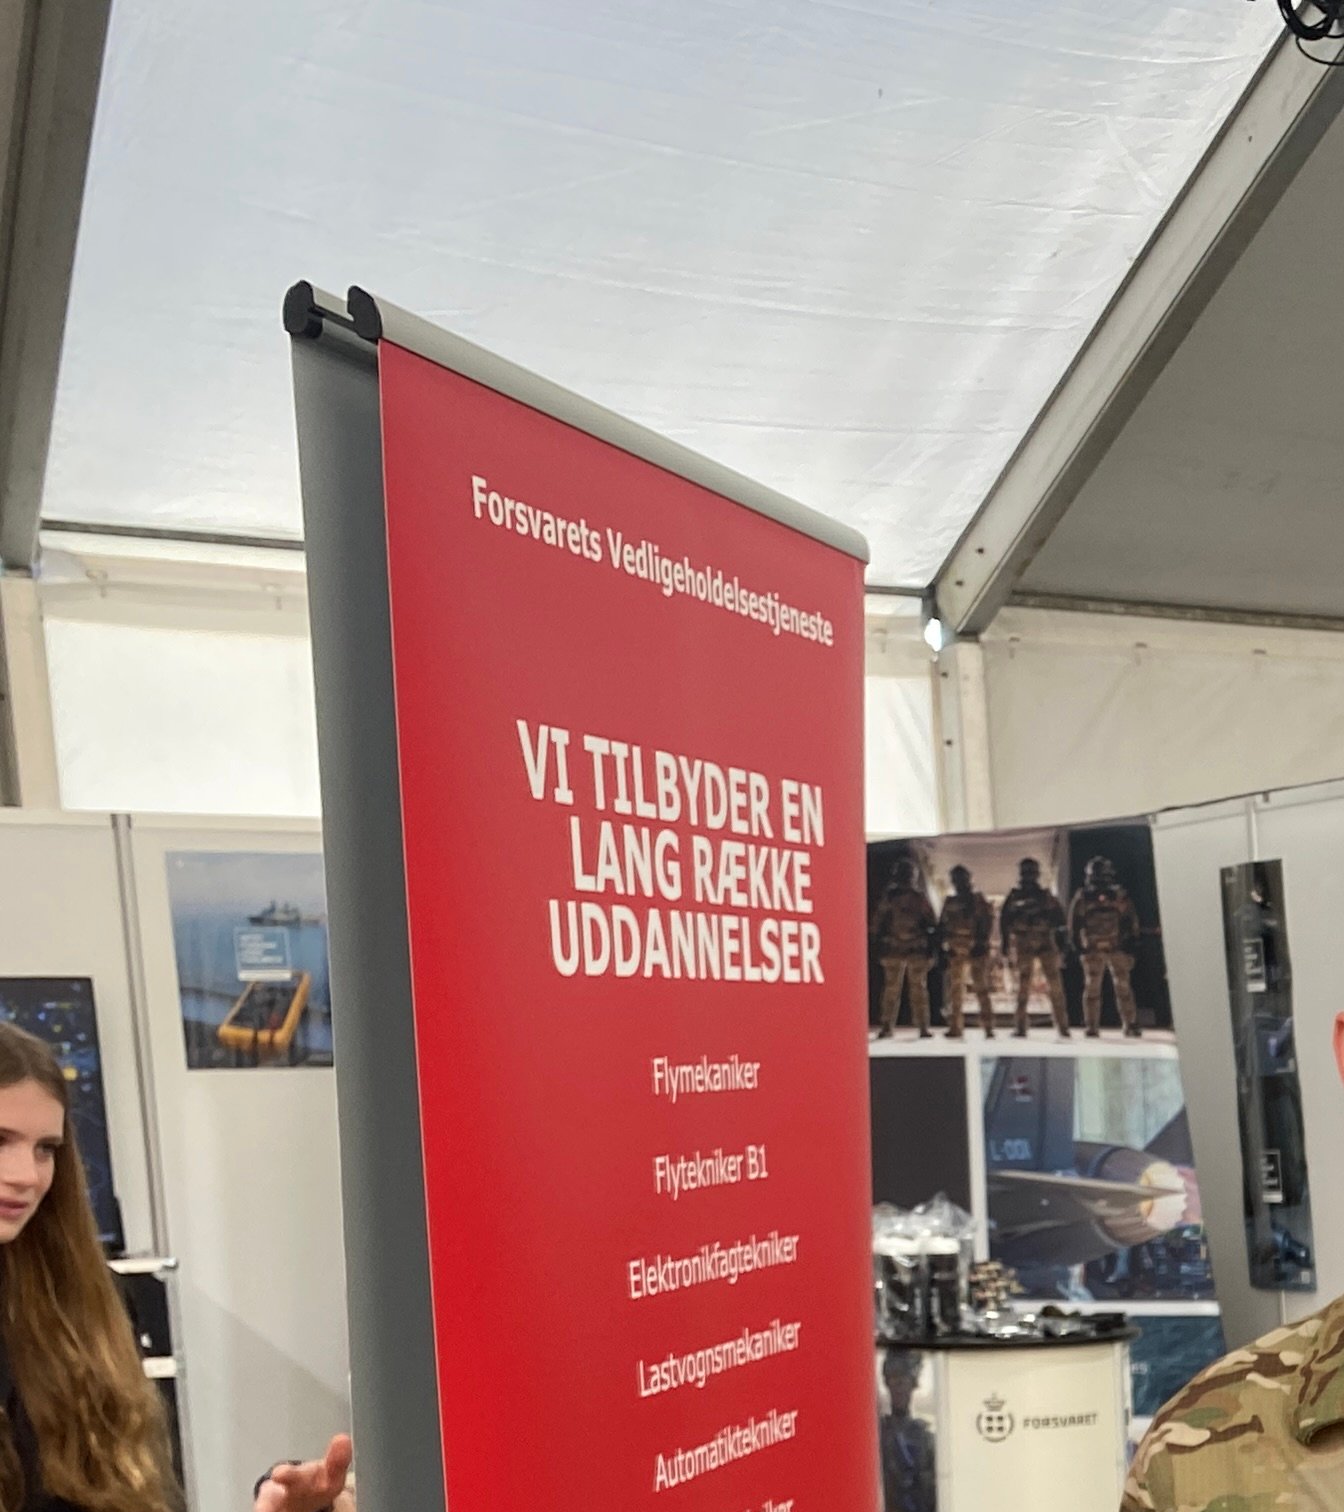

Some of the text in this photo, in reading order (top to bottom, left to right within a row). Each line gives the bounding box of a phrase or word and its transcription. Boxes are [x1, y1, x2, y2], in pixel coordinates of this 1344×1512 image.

[471, 475, 834, 646] Forsvarets Vedligeholdelsestjeneste
[516, 719, 825, 847] VI TILBYDER EN
[570, 815, 813, 913] LANG RÆKKE
[549, 899, 825, 983] UDDANNELSER
[652, 1054, 760, 1103] Flymekaniker
[653, 1144, 769, 1200] Flytekniker B1
[629, 1231, 799, 1300] Elektronikfagtekniker
[637, 1319, 801, 1397] Lastvognsmekaniker
[653, 1408, 798, 1492] Automatiktekniker
[1023, 1413, 1097, 1429] FORSVARET
